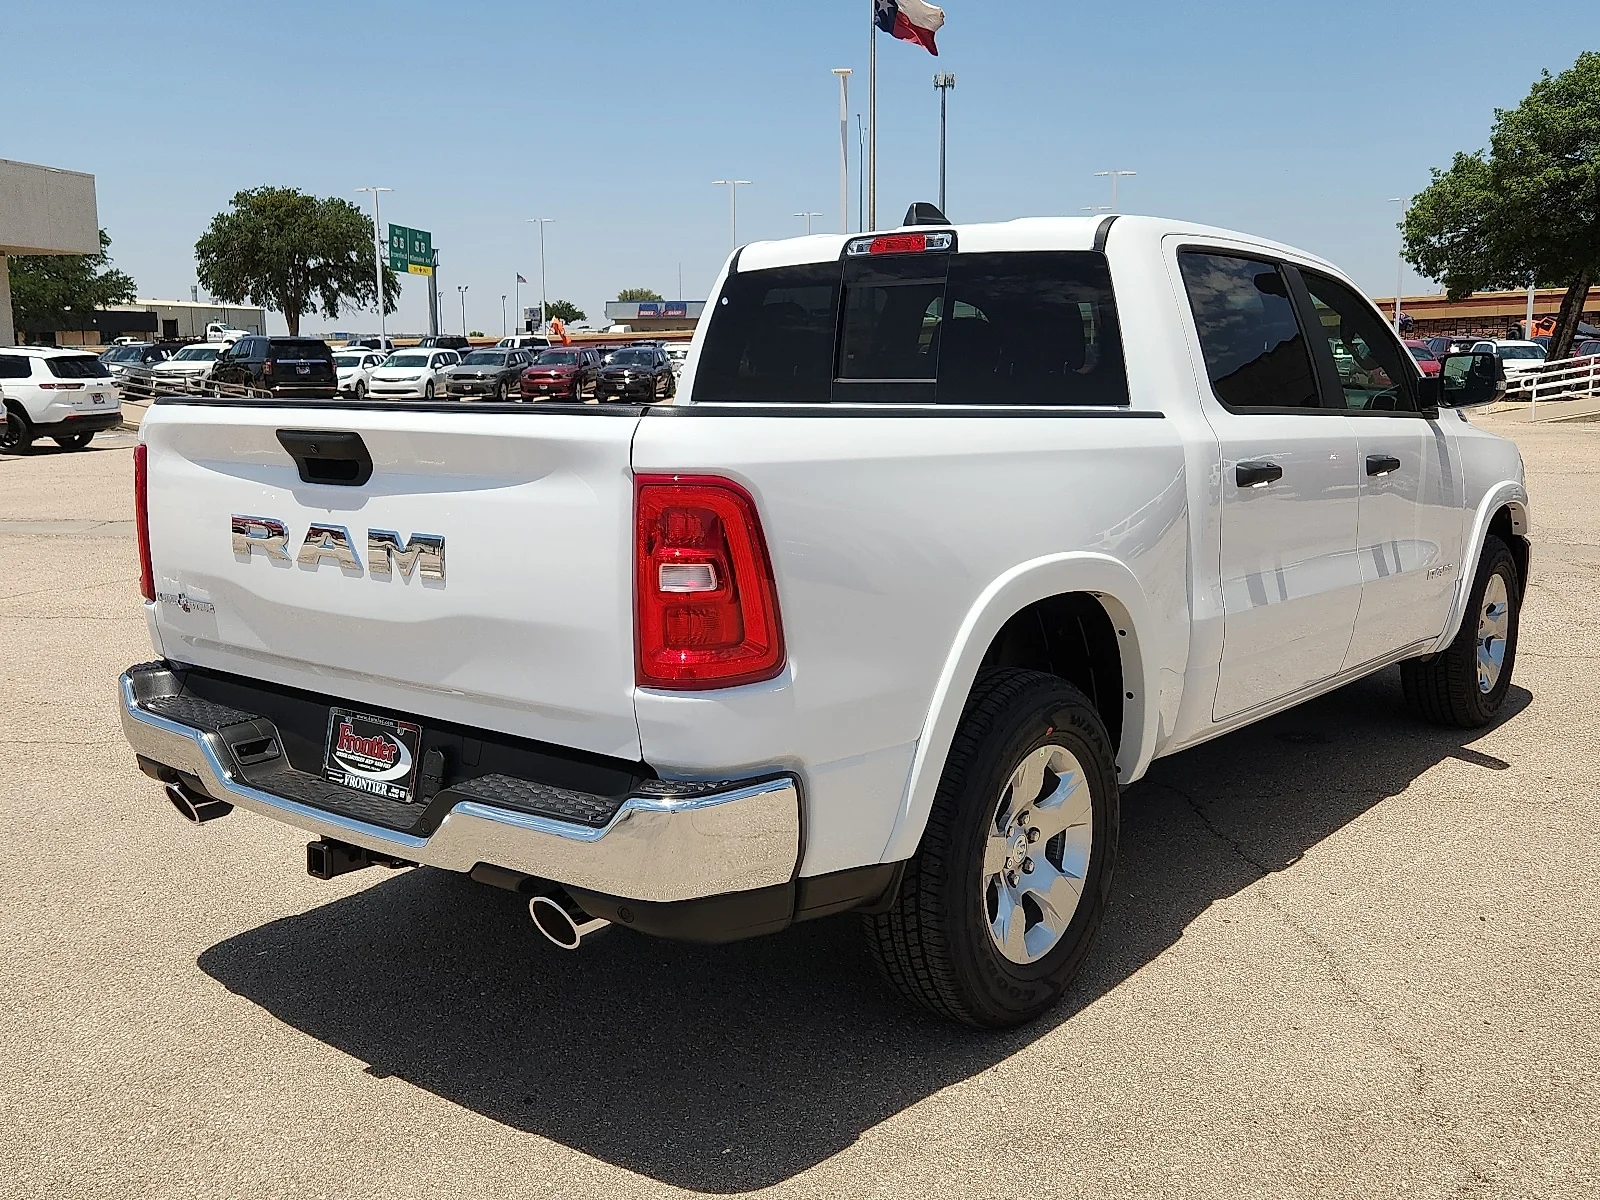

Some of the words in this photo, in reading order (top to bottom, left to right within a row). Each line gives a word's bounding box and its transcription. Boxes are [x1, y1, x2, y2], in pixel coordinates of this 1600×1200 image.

[231, 514, 446, 581] RAM
[337, 723, 397, 763] Frontier
[344, 773, 388, 796] FRONTIER
